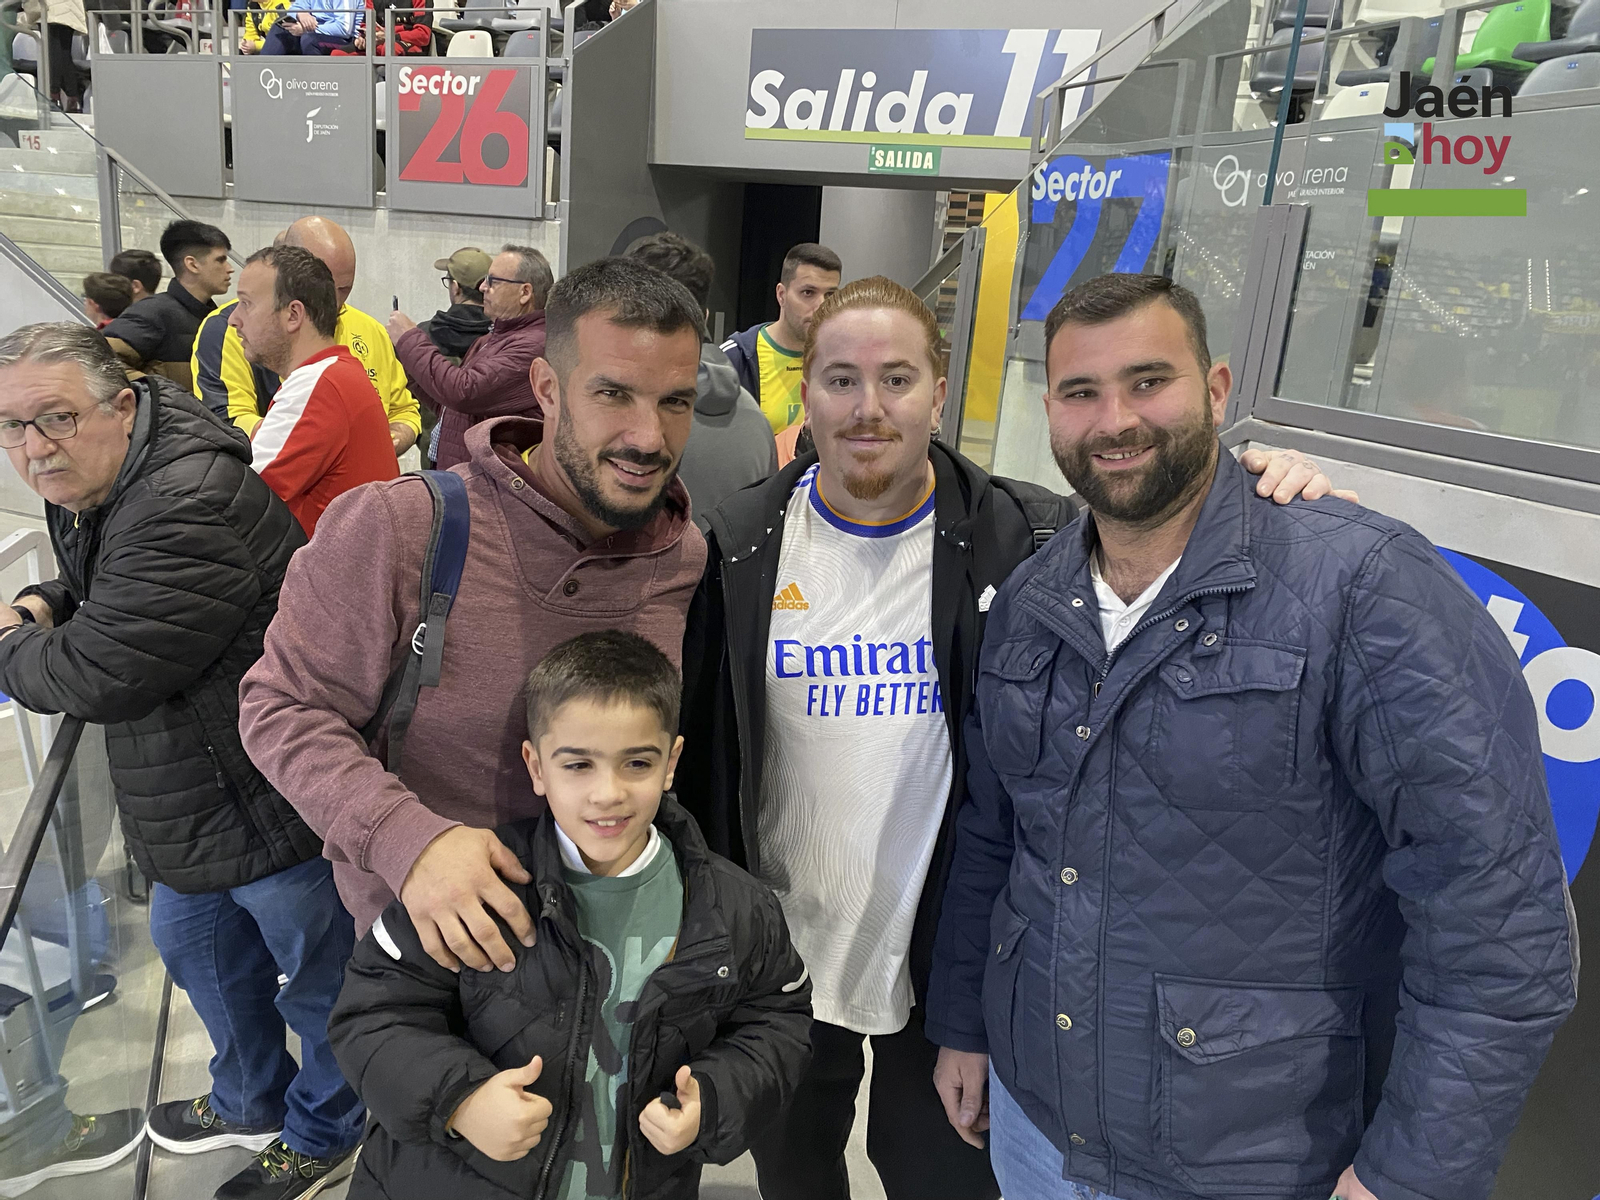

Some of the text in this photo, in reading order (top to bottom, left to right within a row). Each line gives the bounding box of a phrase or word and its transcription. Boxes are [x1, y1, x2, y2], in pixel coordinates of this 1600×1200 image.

[286, 78, 339, 91] olivo arena
[398, 66, 481, 95] Sector
[745, 29, 1103, 137] Salida 11
[398, 65, 529, 186] 26
[875, 150, 933, 169] SALIDA
[1031, 161, 1123, 201] Sector
[1020, 152, 1172, 321] 27
[1305, 249, 1336, 260] TACIÓN
[772, 600, 810, 611] adidas
[774, 633, 937, 679] Emirat
[807, 684, 847, 717] FLY
